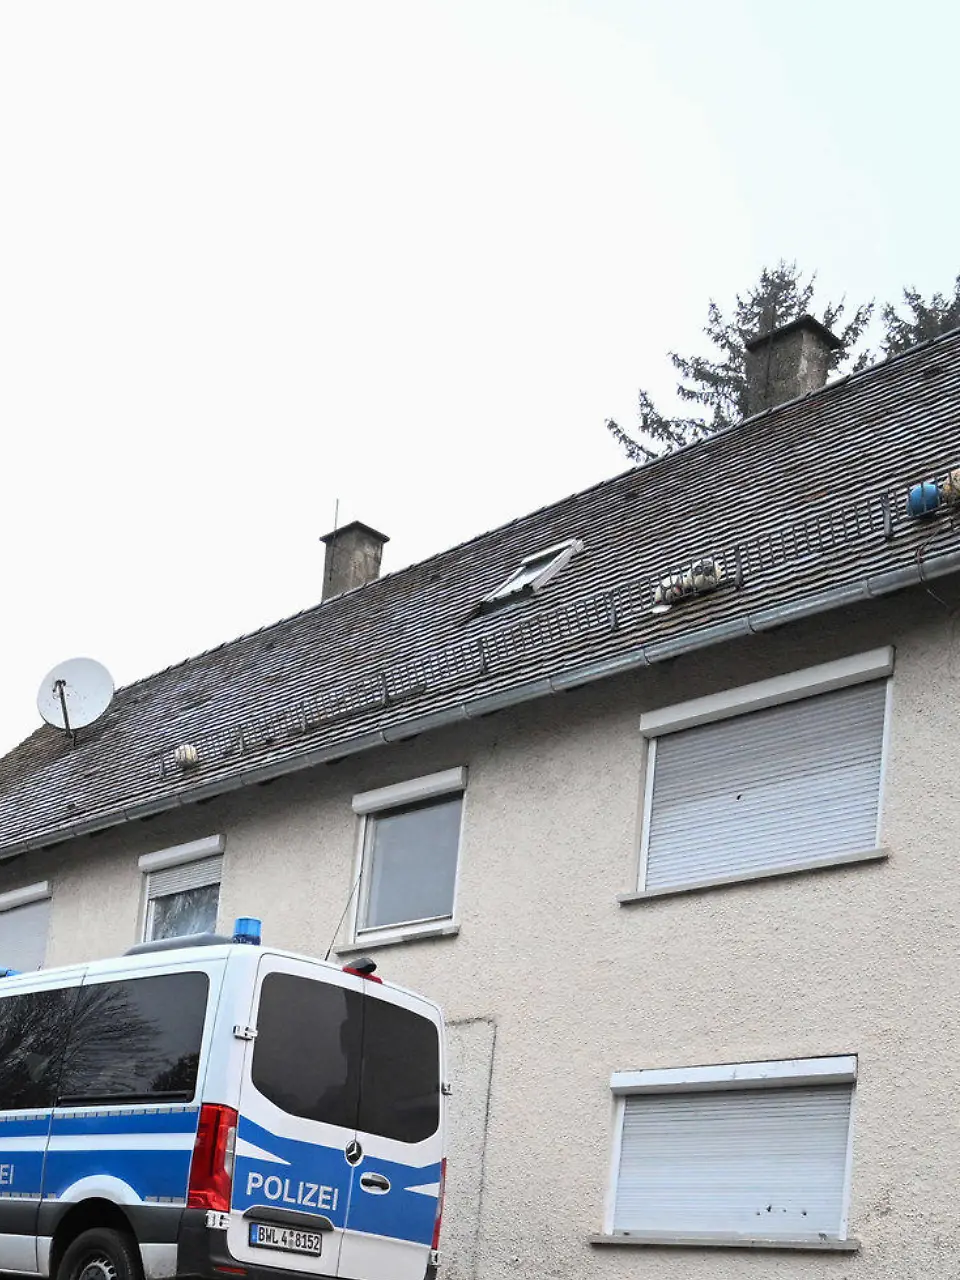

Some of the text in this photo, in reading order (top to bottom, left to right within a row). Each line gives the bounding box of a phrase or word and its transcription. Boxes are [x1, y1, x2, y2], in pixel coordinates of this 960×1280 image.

[246, 1171, 339, 1211] POLIZEI
[259, 1226, 279, 1244] BWL
[295, 1233, 320, 1251] 8152
